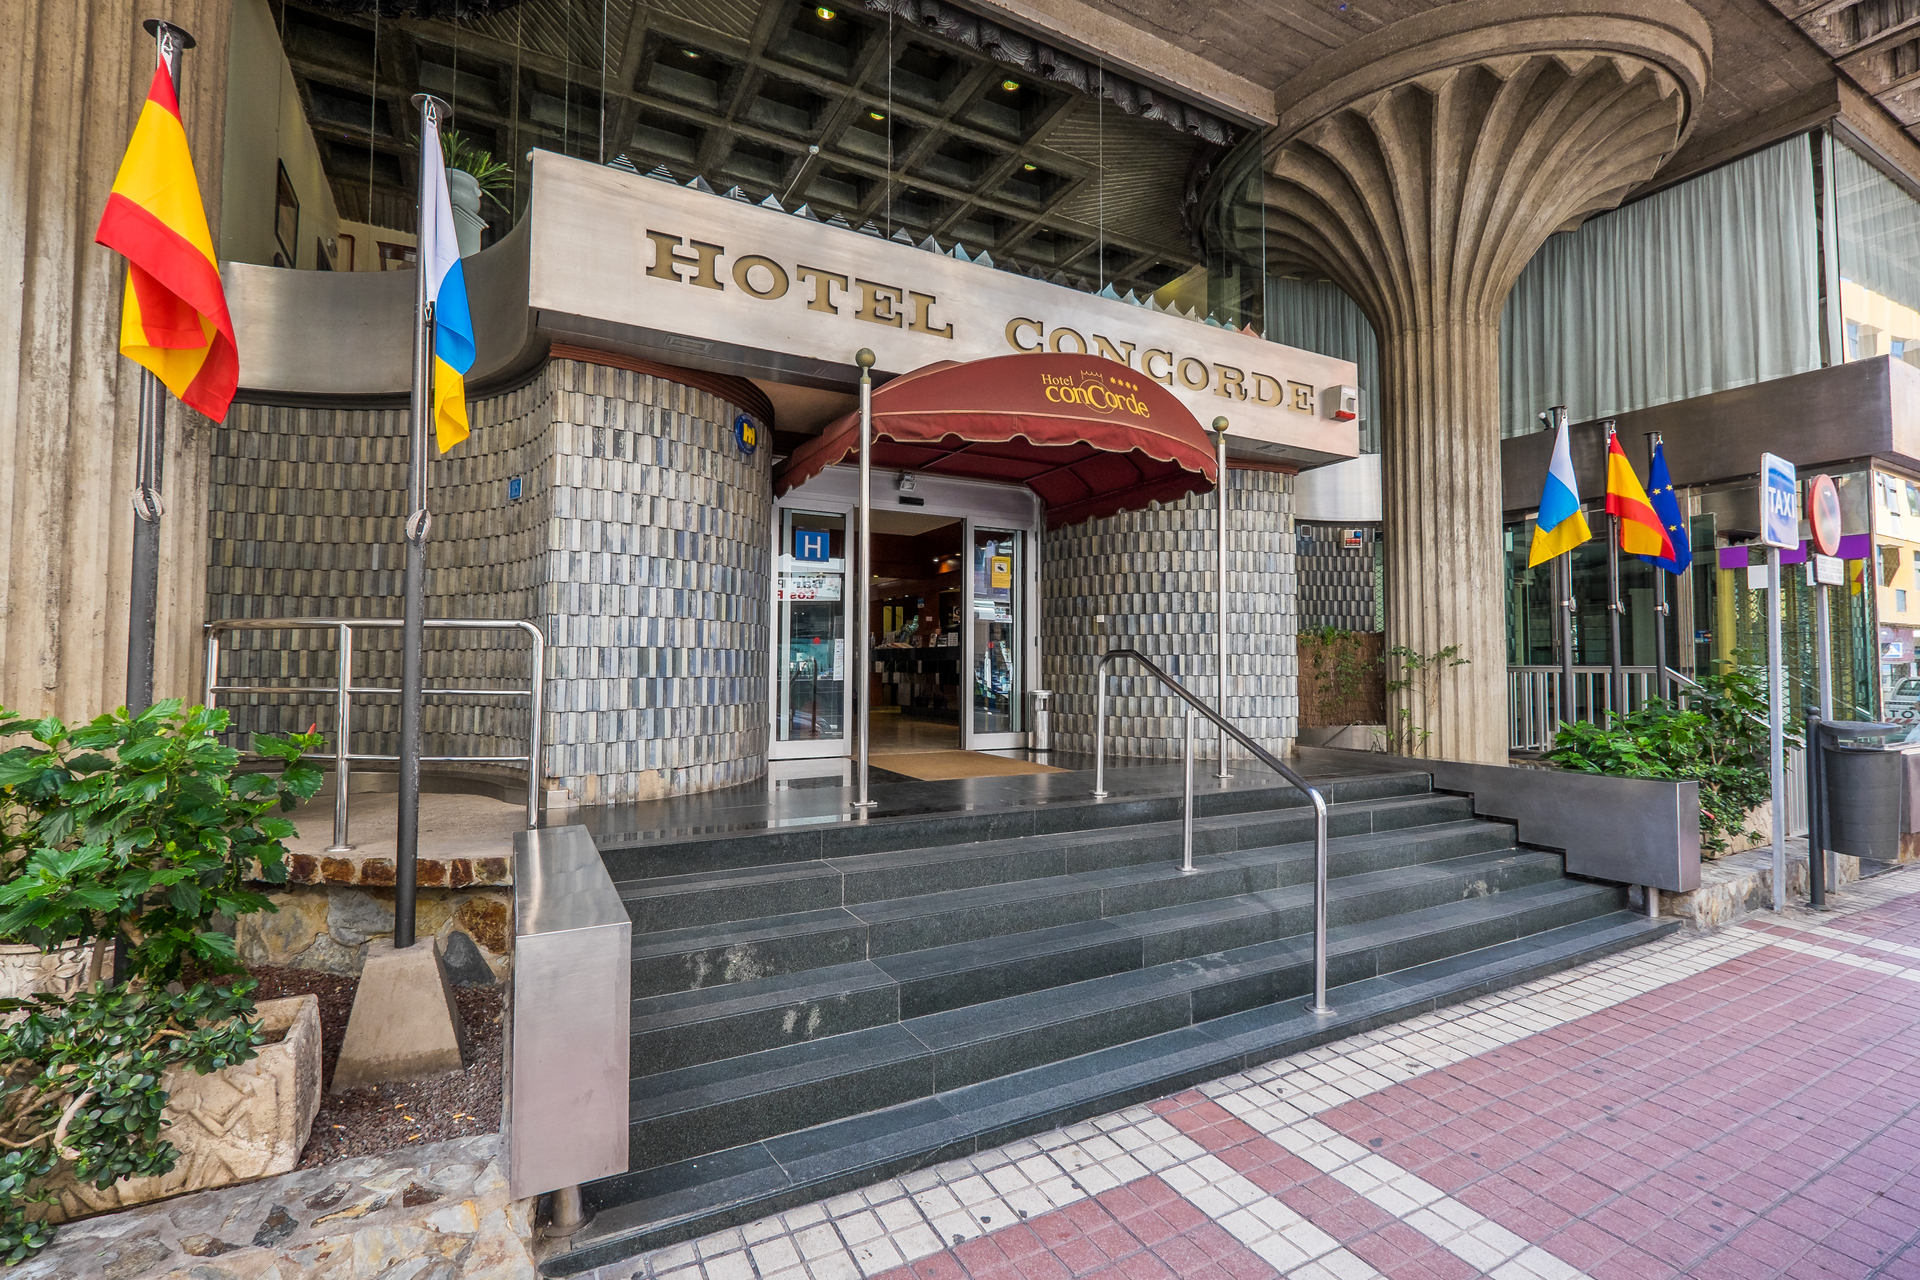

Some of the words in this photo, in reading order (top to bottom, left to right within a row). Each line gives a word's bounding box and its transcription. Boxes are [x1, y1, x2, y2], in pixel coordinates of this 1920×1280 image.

[646, 228, 953, 339] HOTEL
[1004, 317, 1314, 415] CONCORDE
[1041, 374, 1074, 386] Hotel
[1768, 486, 1796, 519] TAXI
[804, 535, 821, 558] H
